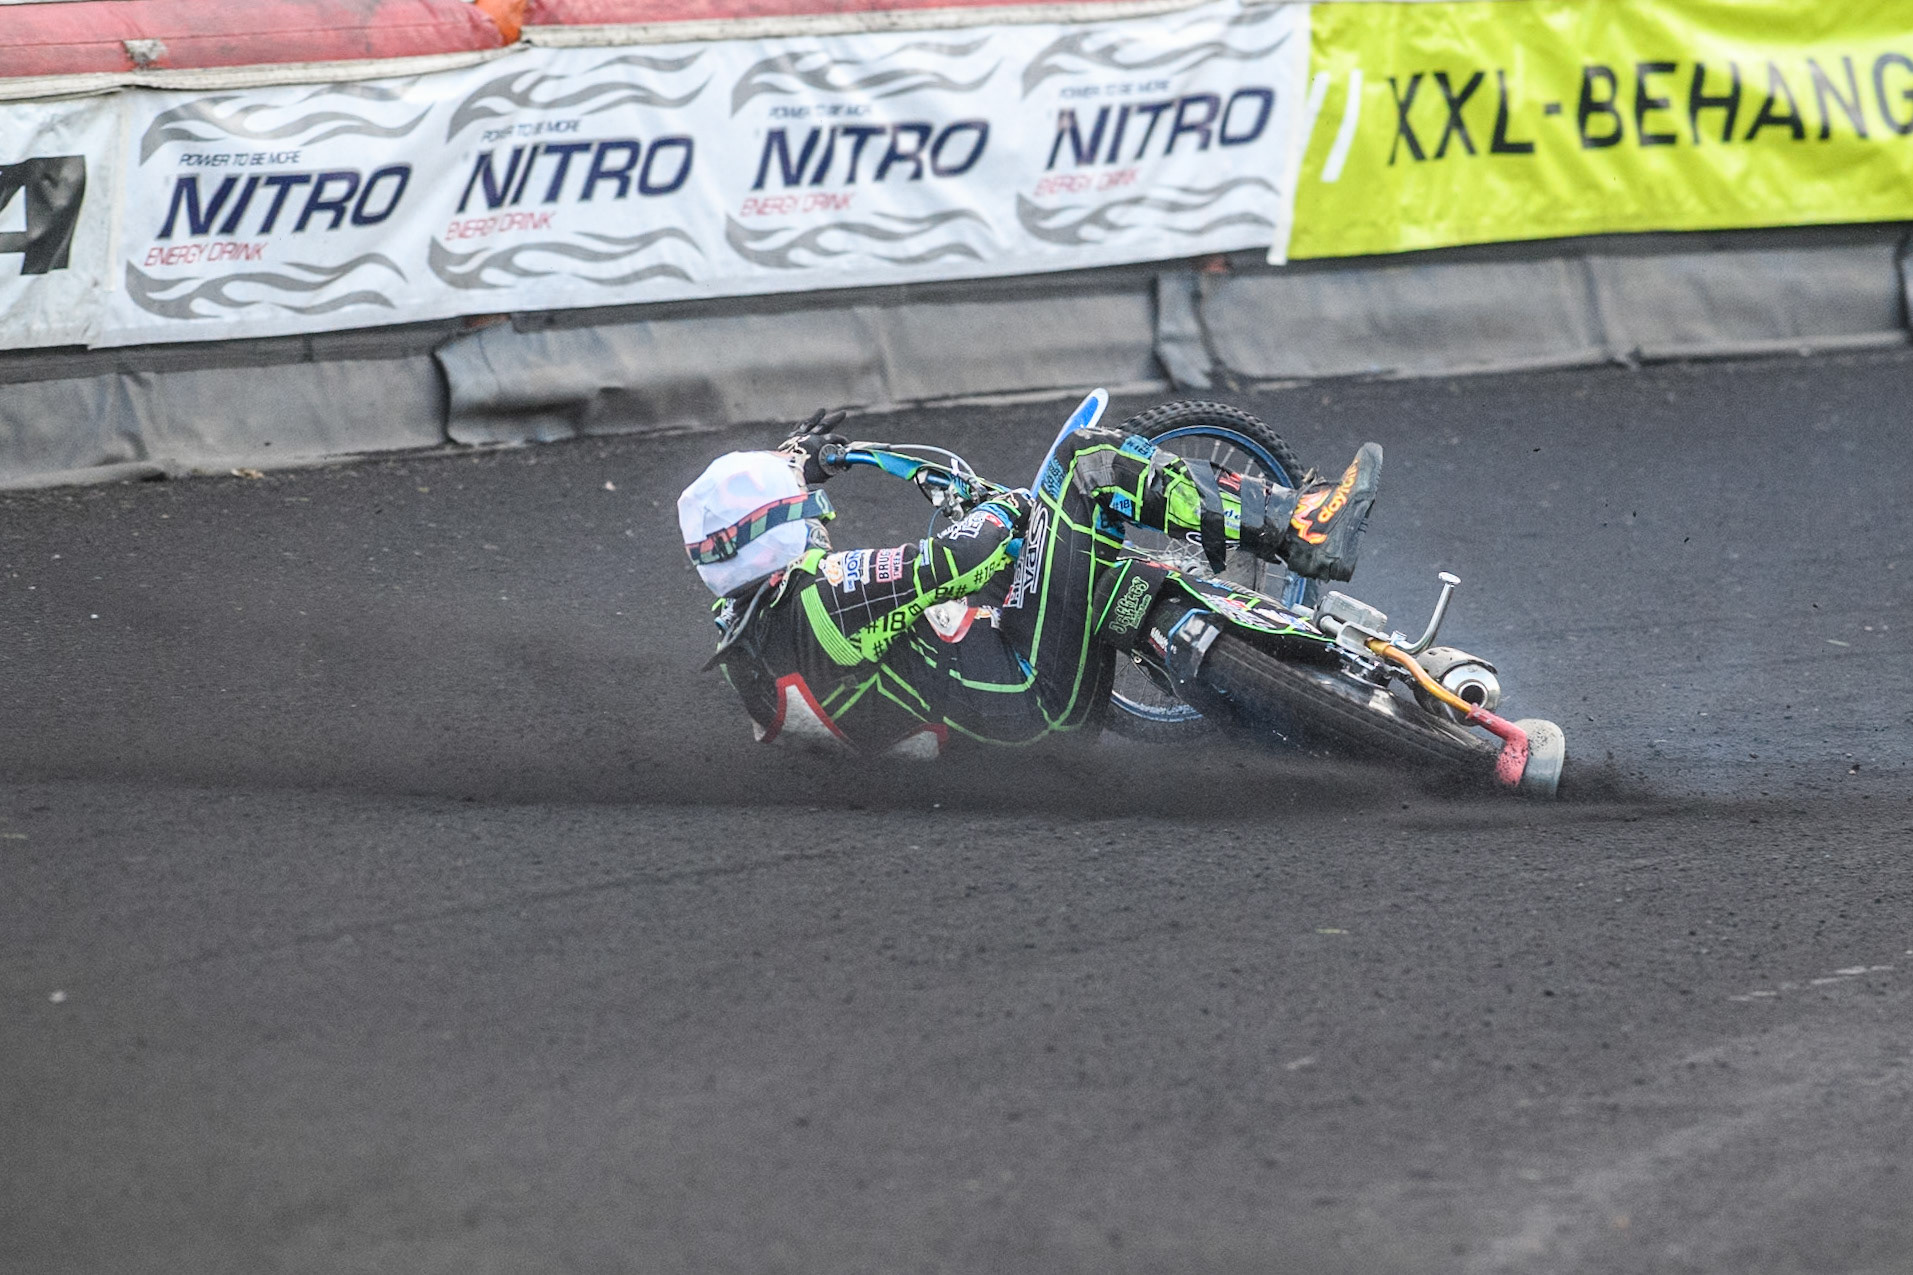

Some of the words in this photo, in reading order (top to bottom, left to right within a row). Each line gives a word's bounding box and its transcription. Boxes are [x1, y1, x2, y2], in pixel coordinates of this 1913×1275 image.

[1045, 87, 1276, 170] NITRO
[178, 152, 231, 167] POWER
[232, 152, 249, 166] TO
[250, 151, 267, 165] BE
[268, 149, 302, 164] MORE
[456, 134, 694, 214] NITRO
[751, 119, 989, 191] NITRO
[156, 162, 412, 240] NITRO
[499, 211, 557, 233] DRINK
[144, 243, 208, 267] ENERGY
[208, 241, 269, 262] DRINK
[865, 611, 906, 634] #18
